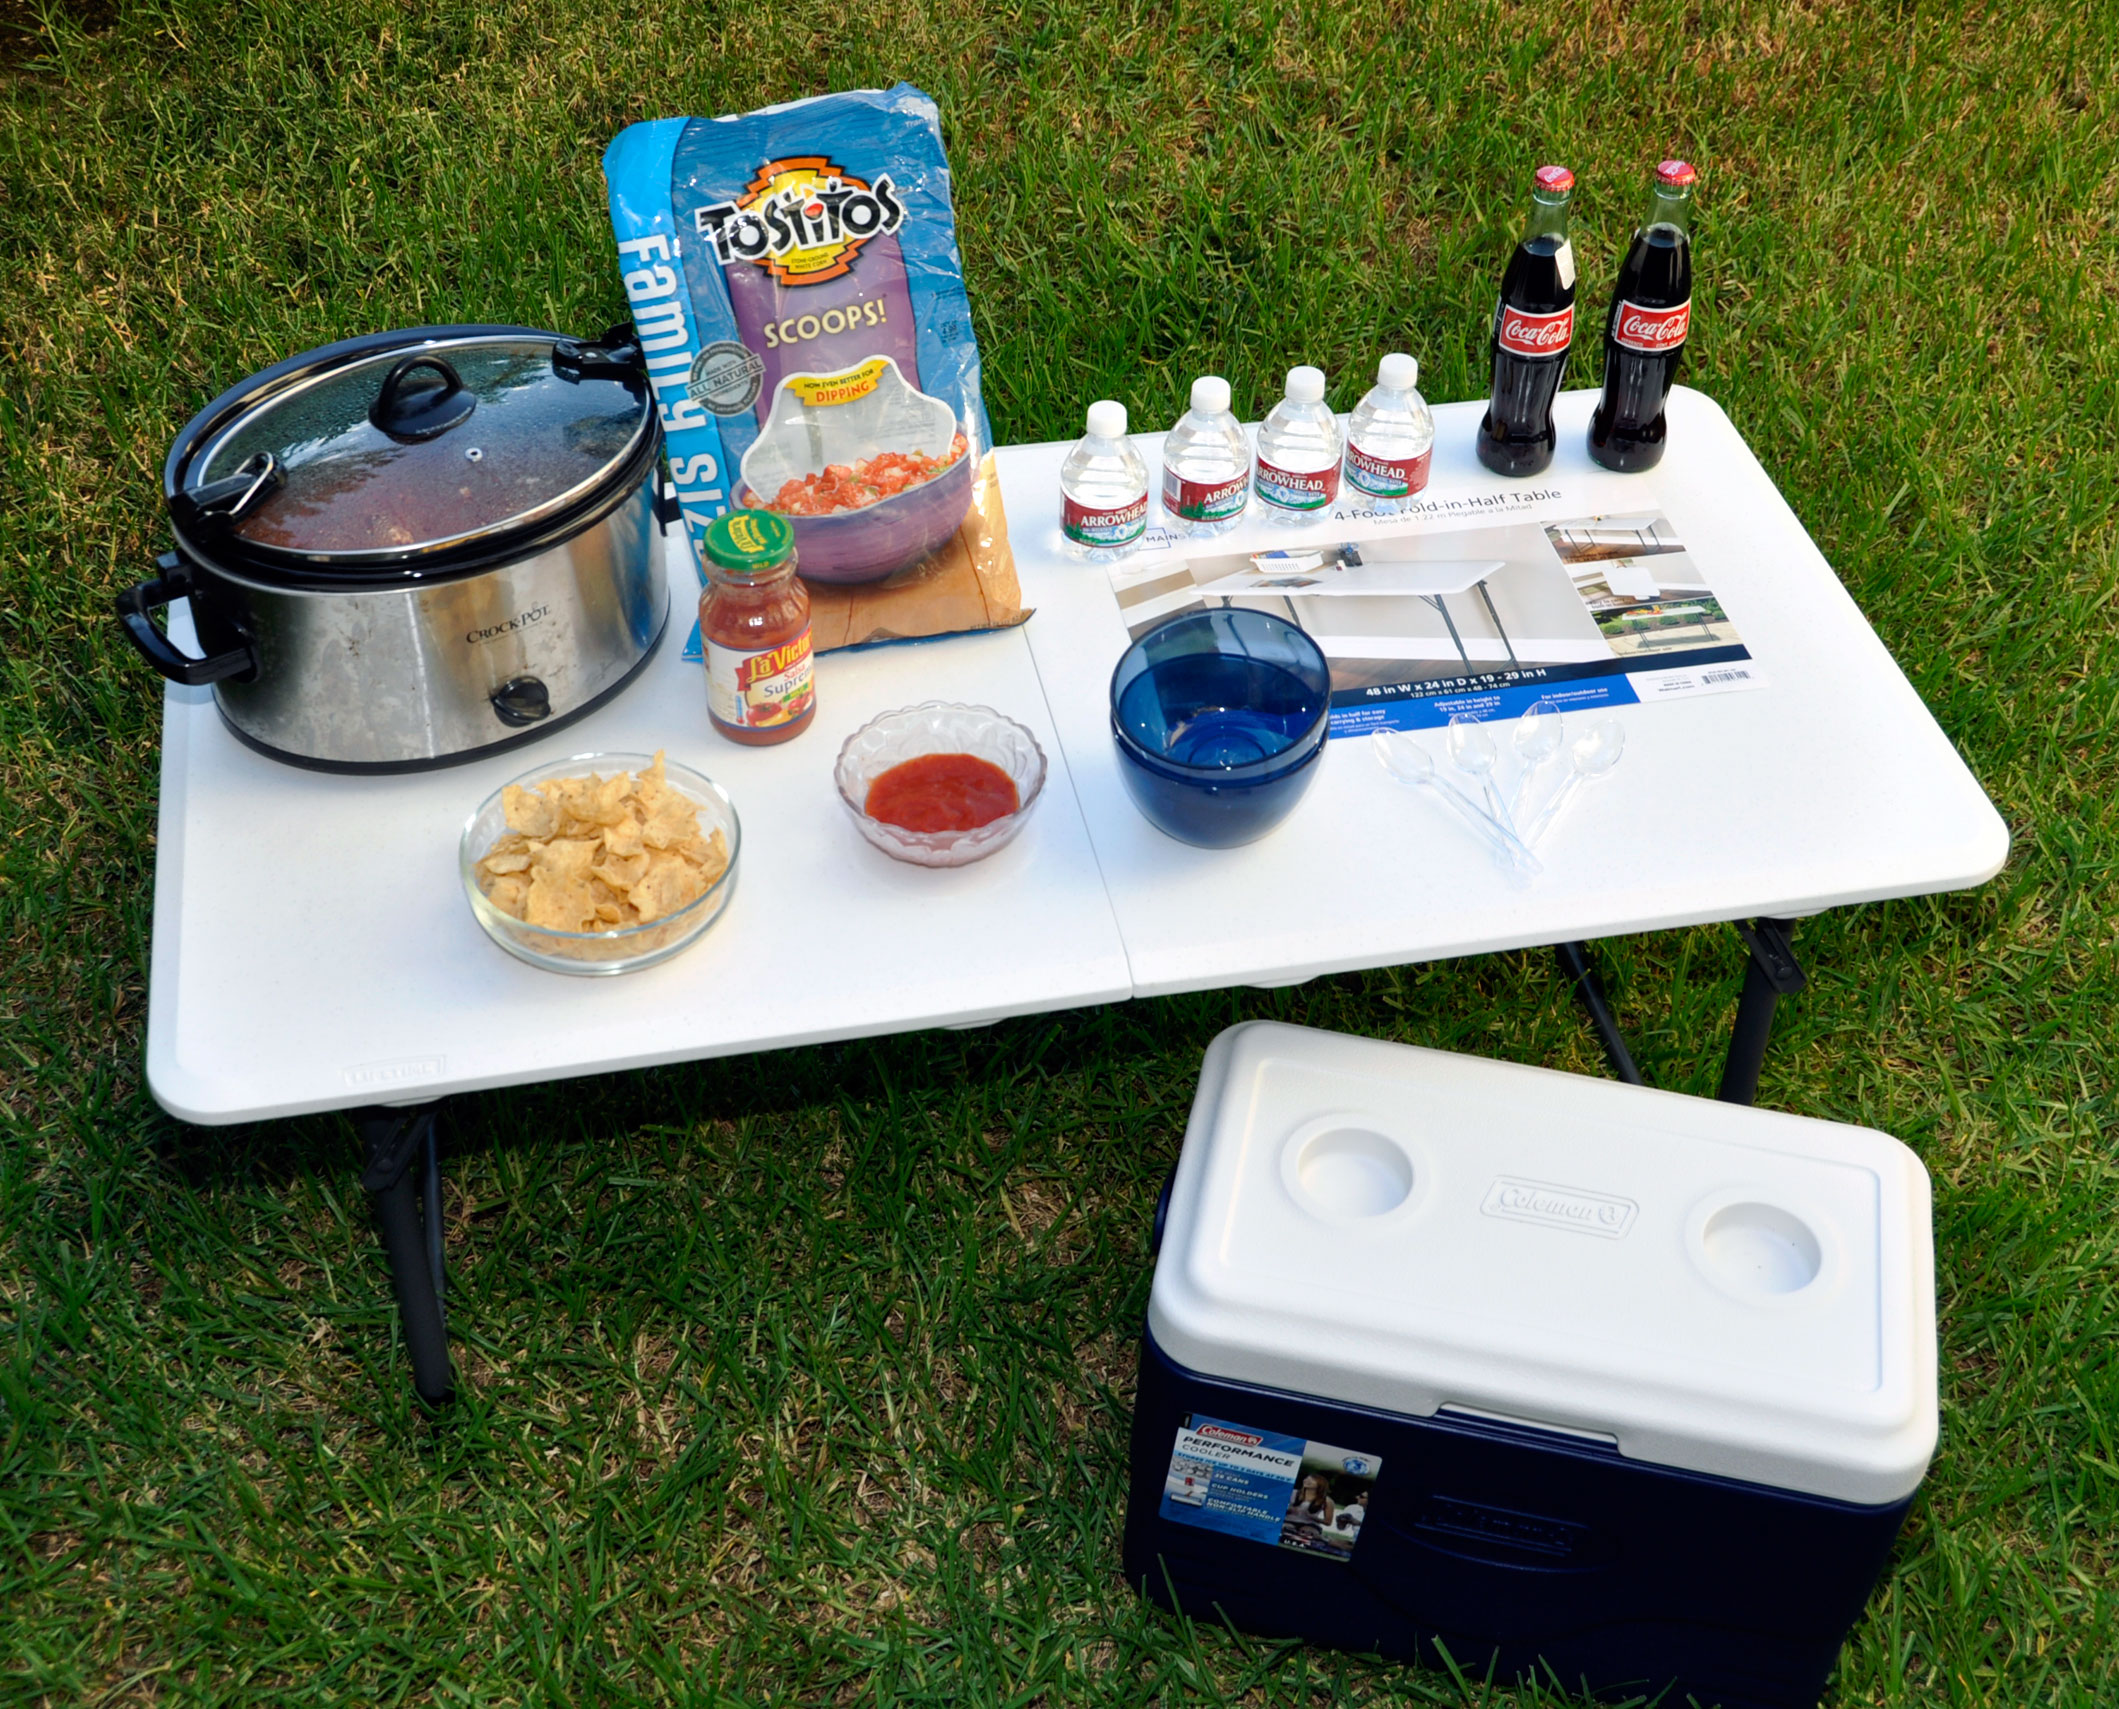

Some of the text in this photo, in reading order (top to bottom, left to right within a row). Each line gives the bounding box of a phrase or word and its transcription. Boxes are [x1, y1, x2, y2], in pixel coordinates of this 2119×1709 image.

[697, 175, 903, 263] TOSTITOS
[763, 299, 888, 349] SCOOPS!
[1505, 317, 1569, 346] Coca-Cola
[1623, 311, 1687, 341] Coca-Cola
[690, 382, 711, 398] ALL
[713, 360, 762, 387] NATURAL
[861, 368, 874, 378] FOR
[816, 381, 870, 403] DIPPING
[669, 452, 726, 555] SIZ
[1510, 489, 1562, 502] Table
[746, 656, 774, 683] La
[1366, 687, 1381, 697] 48
[1384, 686, 1396, 695] in
[1398, 684, 1411, 693] W
[1424, 681, 1440, 691] 24
[1441, 679, 1455, 688] in
[1456, 678, 1467, 686] D
[1480, 674, 1494, 684] 19
[1504, 671, 1519, 680] 29
[1521, 669, 1534, 678] in
[1537, 668, 1547, 677] H
[1202, 1425, 1247, 1443] Coleman
[1182, 1444, 1231, 1460] COOLER
[1183, 1436, 1295, 1468] PERFORMANCE
[1230, 1487, 1269, 1500] HOLDERS
